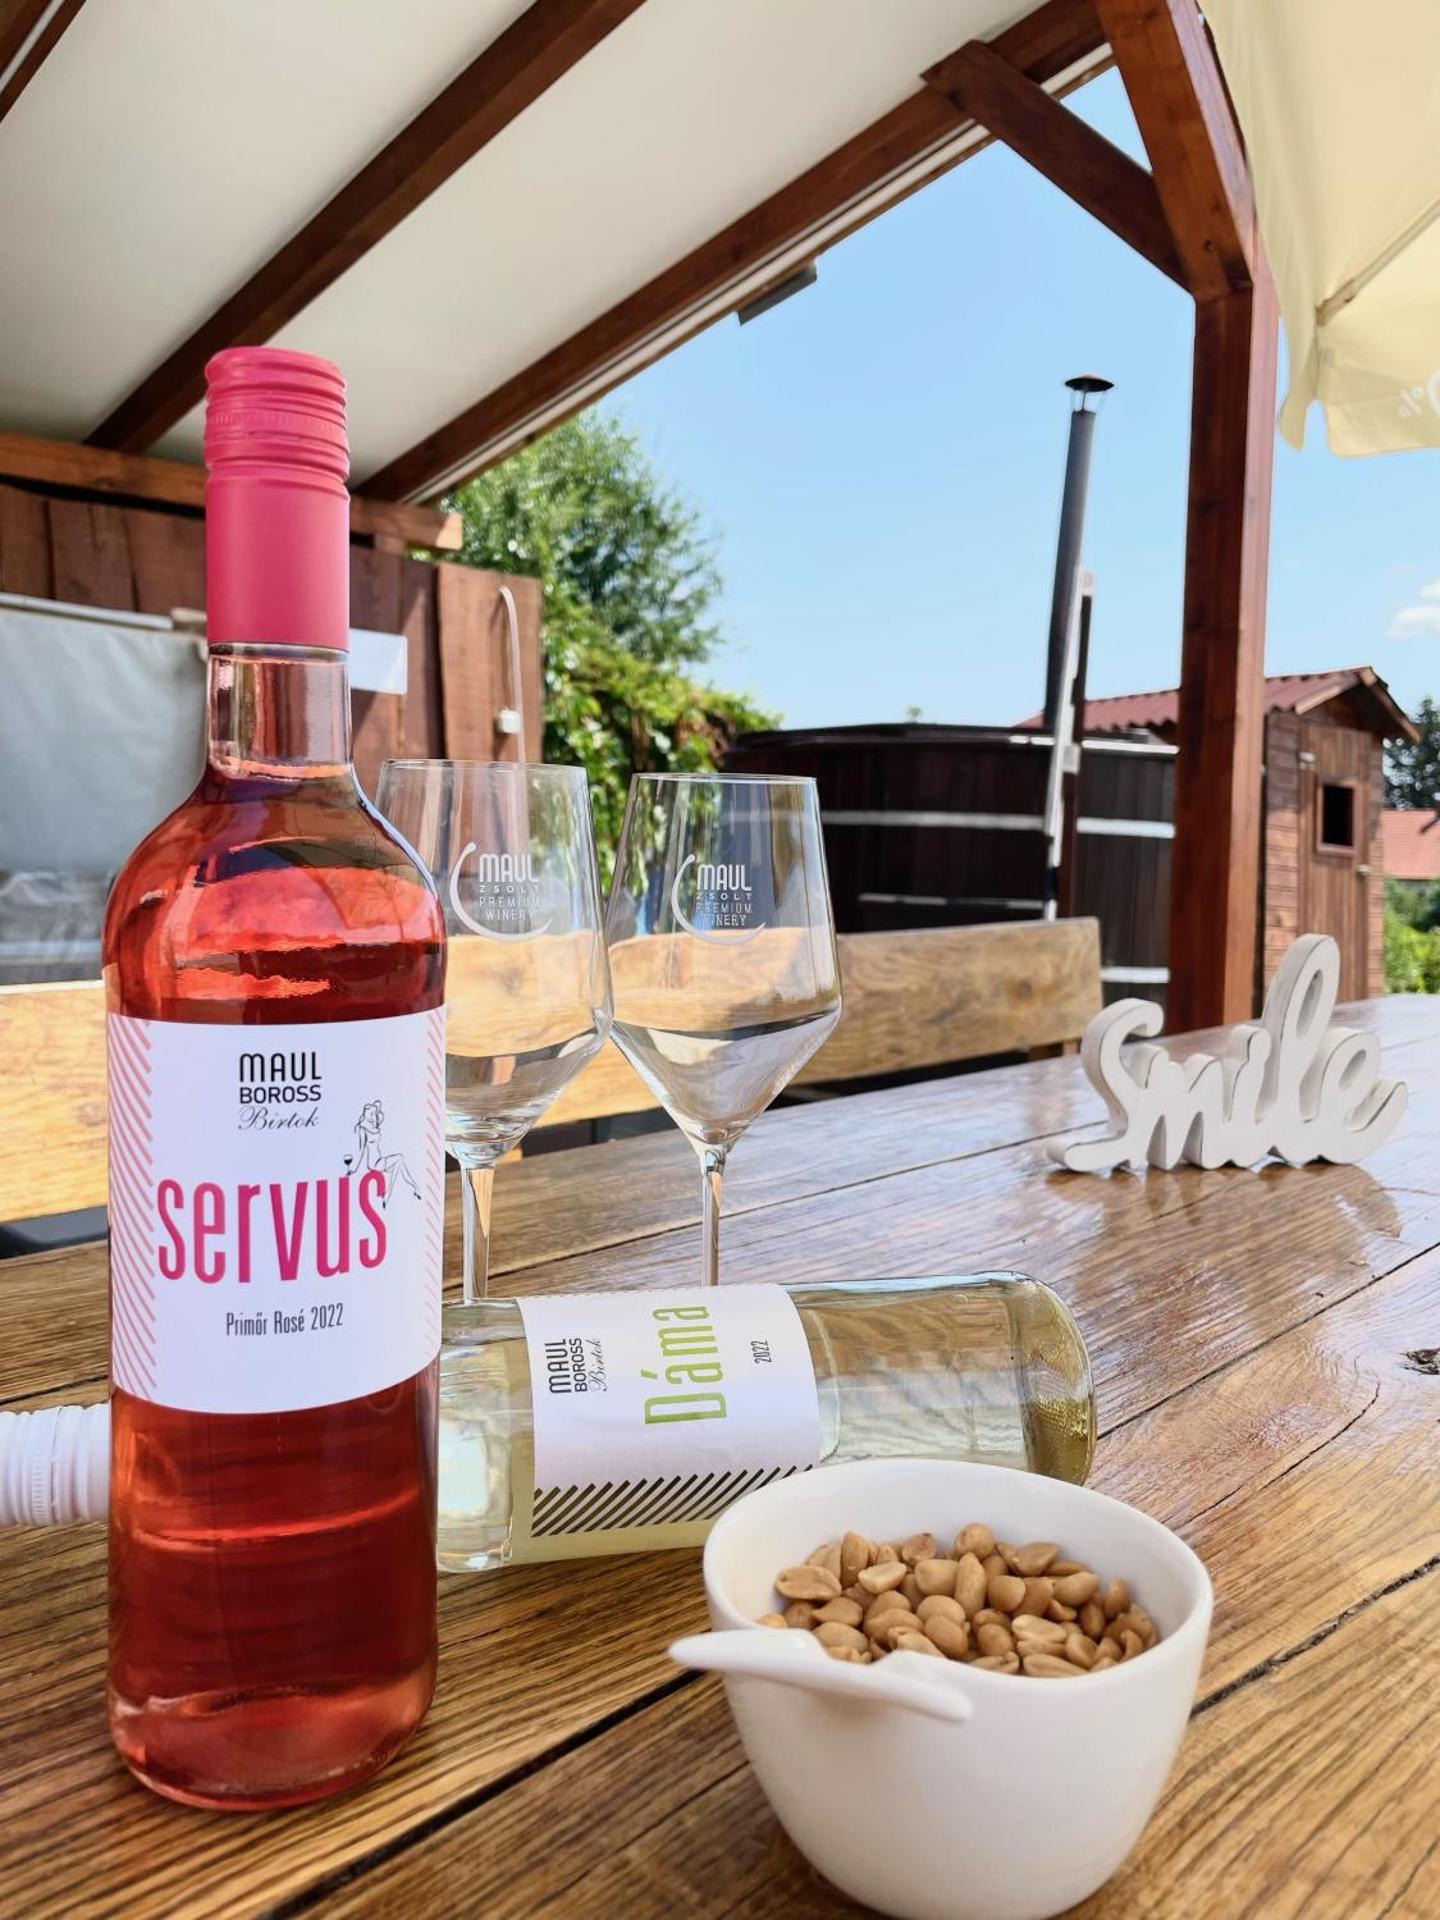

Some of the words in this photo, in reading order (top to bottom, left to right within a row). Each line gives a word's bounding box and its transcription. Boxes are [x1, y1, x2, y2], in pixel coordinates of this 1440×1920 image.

[479, 853, 539, 883] MAUL
[697, 864, 752, 891] MAUL
[479, 885, 540, 894] ZSOLT
[479, 896, 540, 908] PREMIUM
[695, 892, 752, 901] ZSOLT
[485, 908, 535, 920] WINERY
[695, 902, 752, 914] PREMIUM
[701, 914, 747, 926] WINERY
[1046, 933, 1408, 1172] Smile
[239, 1051, 322, 1083] MAUL
[239, 1084, 322, 1105] BOROSS
[237, 1106, 320, 1131] Birtok
[157, 1169, 388, 1284] servus
[226, 1312, 268, 1336] Primőr
[274, 1308, 305, 1335] Rosé
[311, 1302, 344, 1330] 2022
[568, 1338, 588, 1392] BOROSS
[750, 1339, 772, 1365] 2022
[544, 1338, 572, 1394] MAUL
[641, 1306, 727, 1425] Dáma
